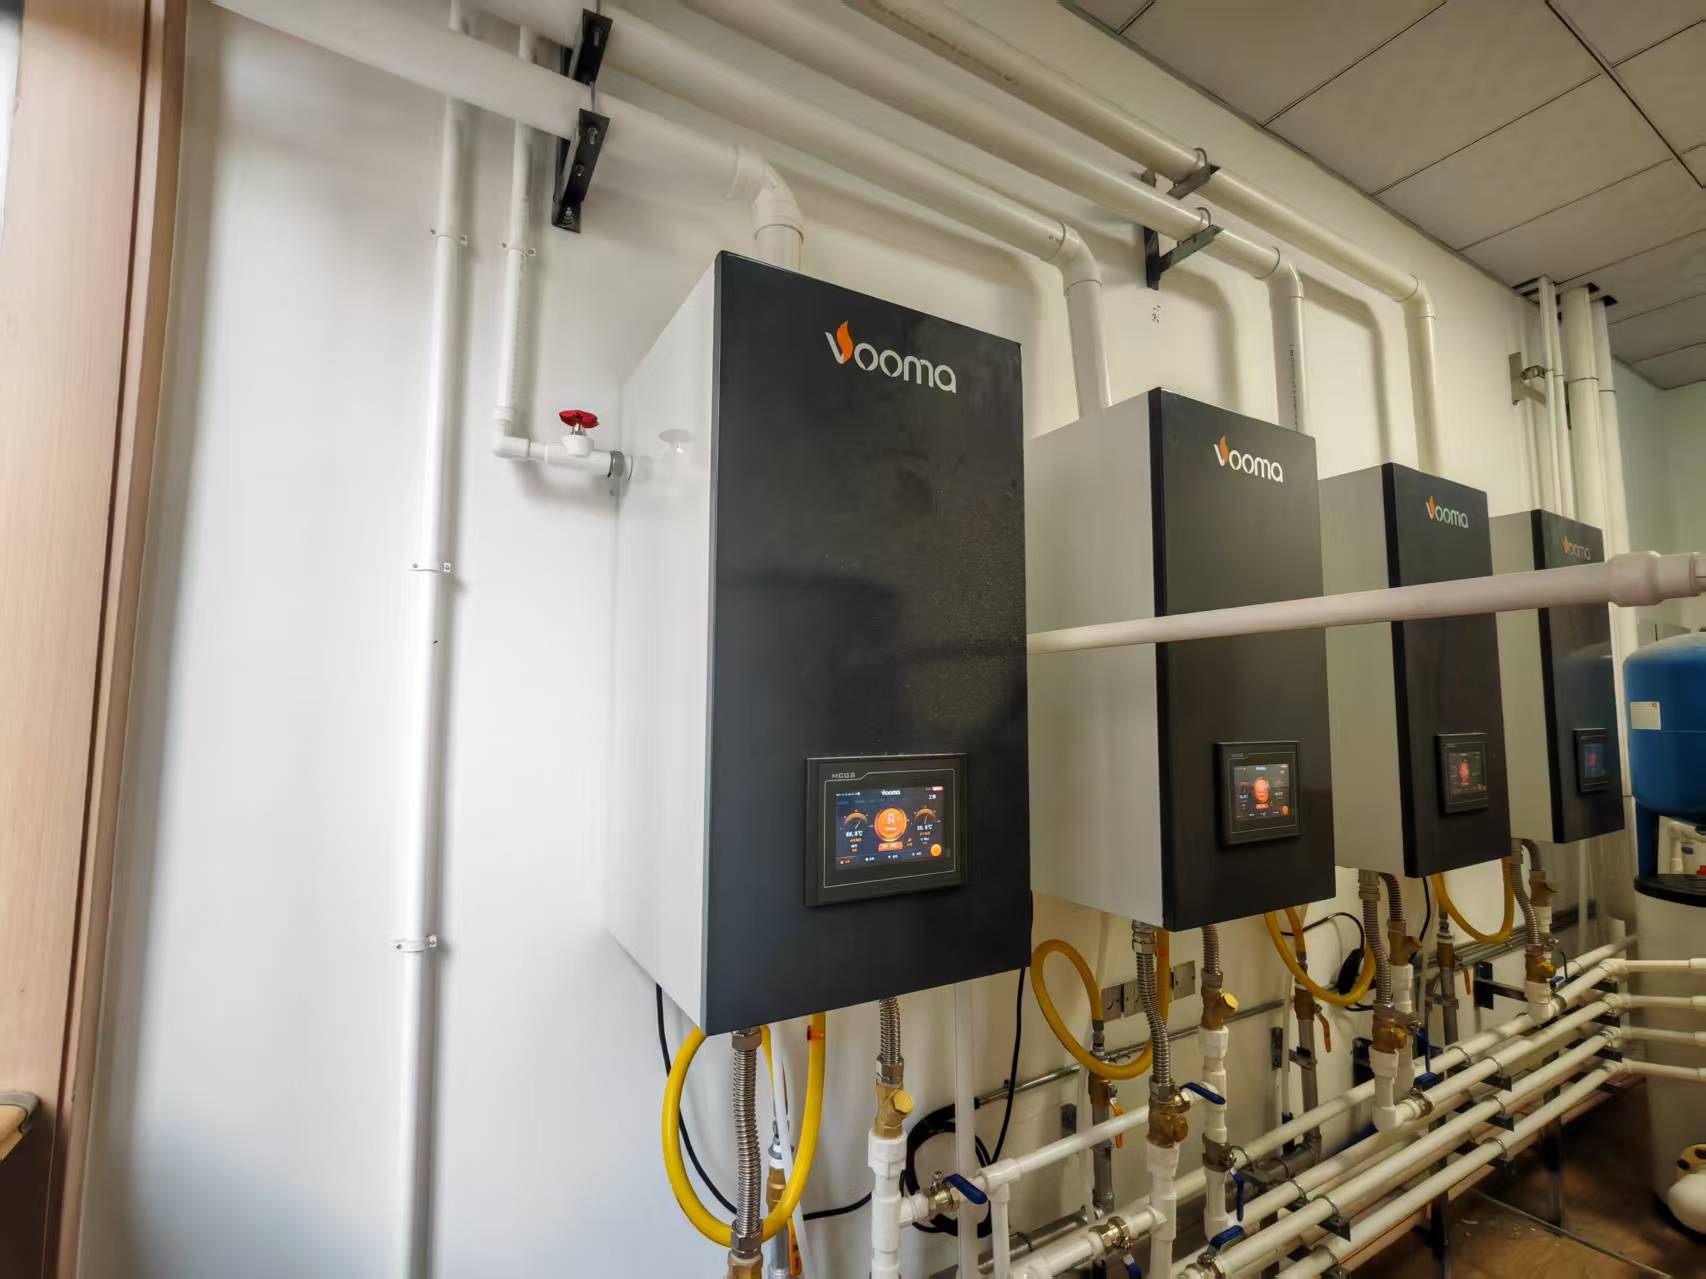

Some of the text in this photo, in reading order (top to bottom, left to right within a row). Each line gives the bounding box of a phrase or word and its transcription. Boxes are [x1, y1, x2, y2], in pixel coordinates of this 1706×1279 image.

[825, 320, 957, 394] Vooma
[1213, 435, 1283, 483] Vooma
[1425, 496, 1469, 529] Vooma
